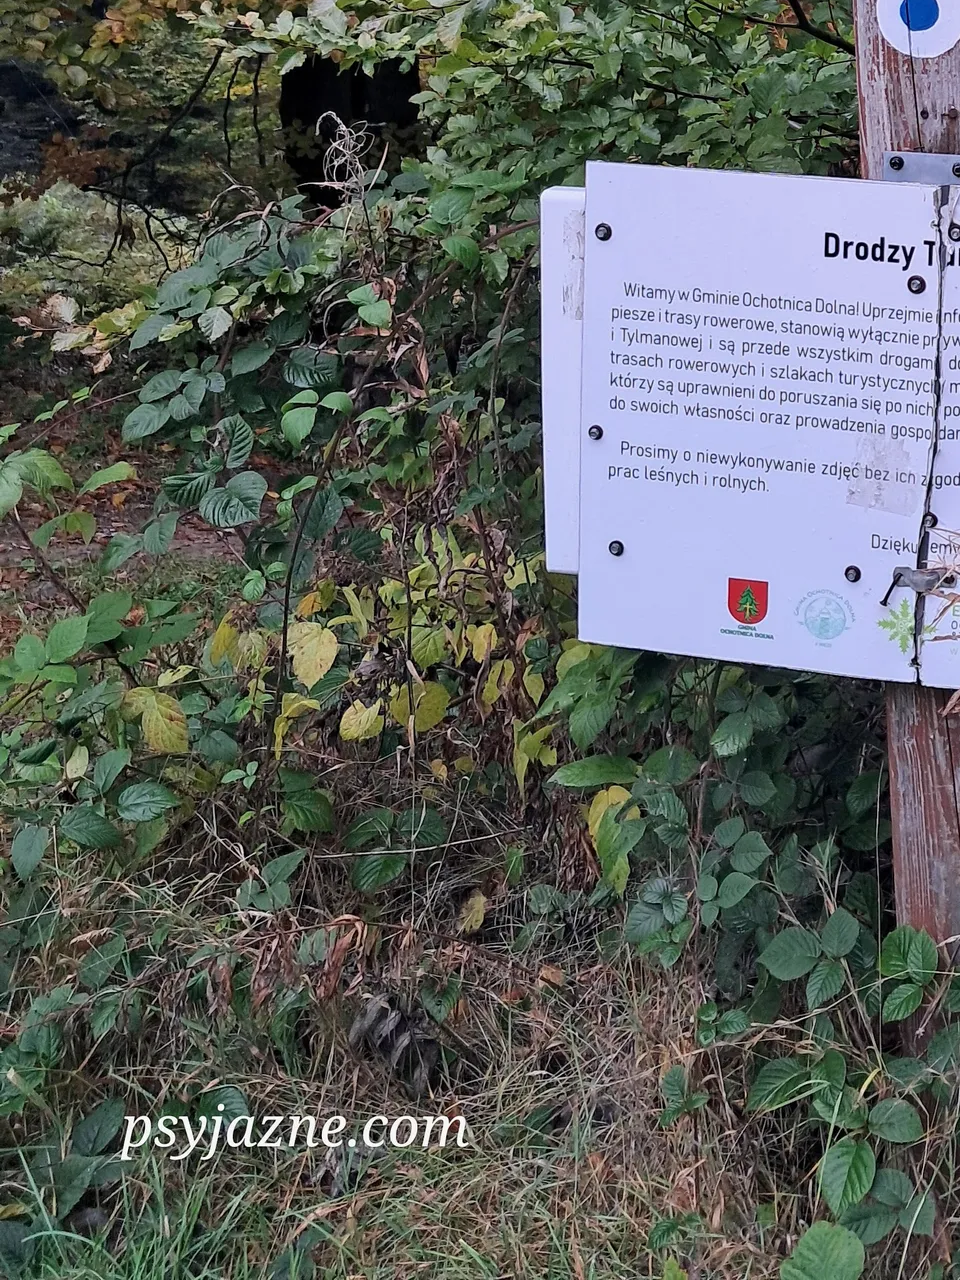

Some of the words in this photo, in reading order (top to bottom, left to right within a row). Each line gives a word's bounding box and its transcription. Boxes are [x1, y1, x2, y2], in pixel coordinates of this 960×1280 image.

[824, 232, 916, 272] Drodzy
[624, 282, 675, 304] Witamy
[678, 290, 689, 301] w
[693, 287, 739, 305] Gminie
[743, 292, 812, 312] Ochotnica
[816, 298, 859, 316] Dolna!
[863, 302, 932, 324] Uprzejmie
[612, 306, 655, 322] piesze
[665, 312, 700, 329] trasy
[704, 316, 777, 334] rowerowe,
[781, 320, 844, 341] stanowią
[848, 326, 919, 345] wyłącznie
[620, 328, 702, 352] Tylmanowej
[719, 340, 734, 355] są
[742, 341, 789, 358] przede
[797, 346, 872, 364] wszystkim
[611, 351, 663, 368] trasach
[669, 358, 755, 379] rowerowych
[771, 365, 833, 383] szlakach
[610, 372, 654, 393] którzy
[658, 380, 673, 396] są
[678, 381, 754, 400] uprawnieni
[759, 386, 775, 400] do
[780, 391, 857, 408] poruszania
[862, 397, 881, 415] się
[886, 401, 902, 416] po
[906, 400, 933, 417] nich
[610, 396, 625, 410] do
[631, 398, 678, 414] swoich
[684, 402, 754, 422] własności
[760, 411, 790, 425] oraz
[796, 415, 885, 434] prowadzenia
[609, 466, 639, 482] prac
[645, 466, 698, 487] leśnych
[713, 474, 768, 494] rolnych.
[621, 441, 678, 463] Prosimy
[684, 450, 691, 461] o
[697, 449, 815, 474] niewykonywanie
[822, 459, 860, 479] zdjęć
[865, 464, 889, 482] bez
[896, 468, 915, 484] ich
